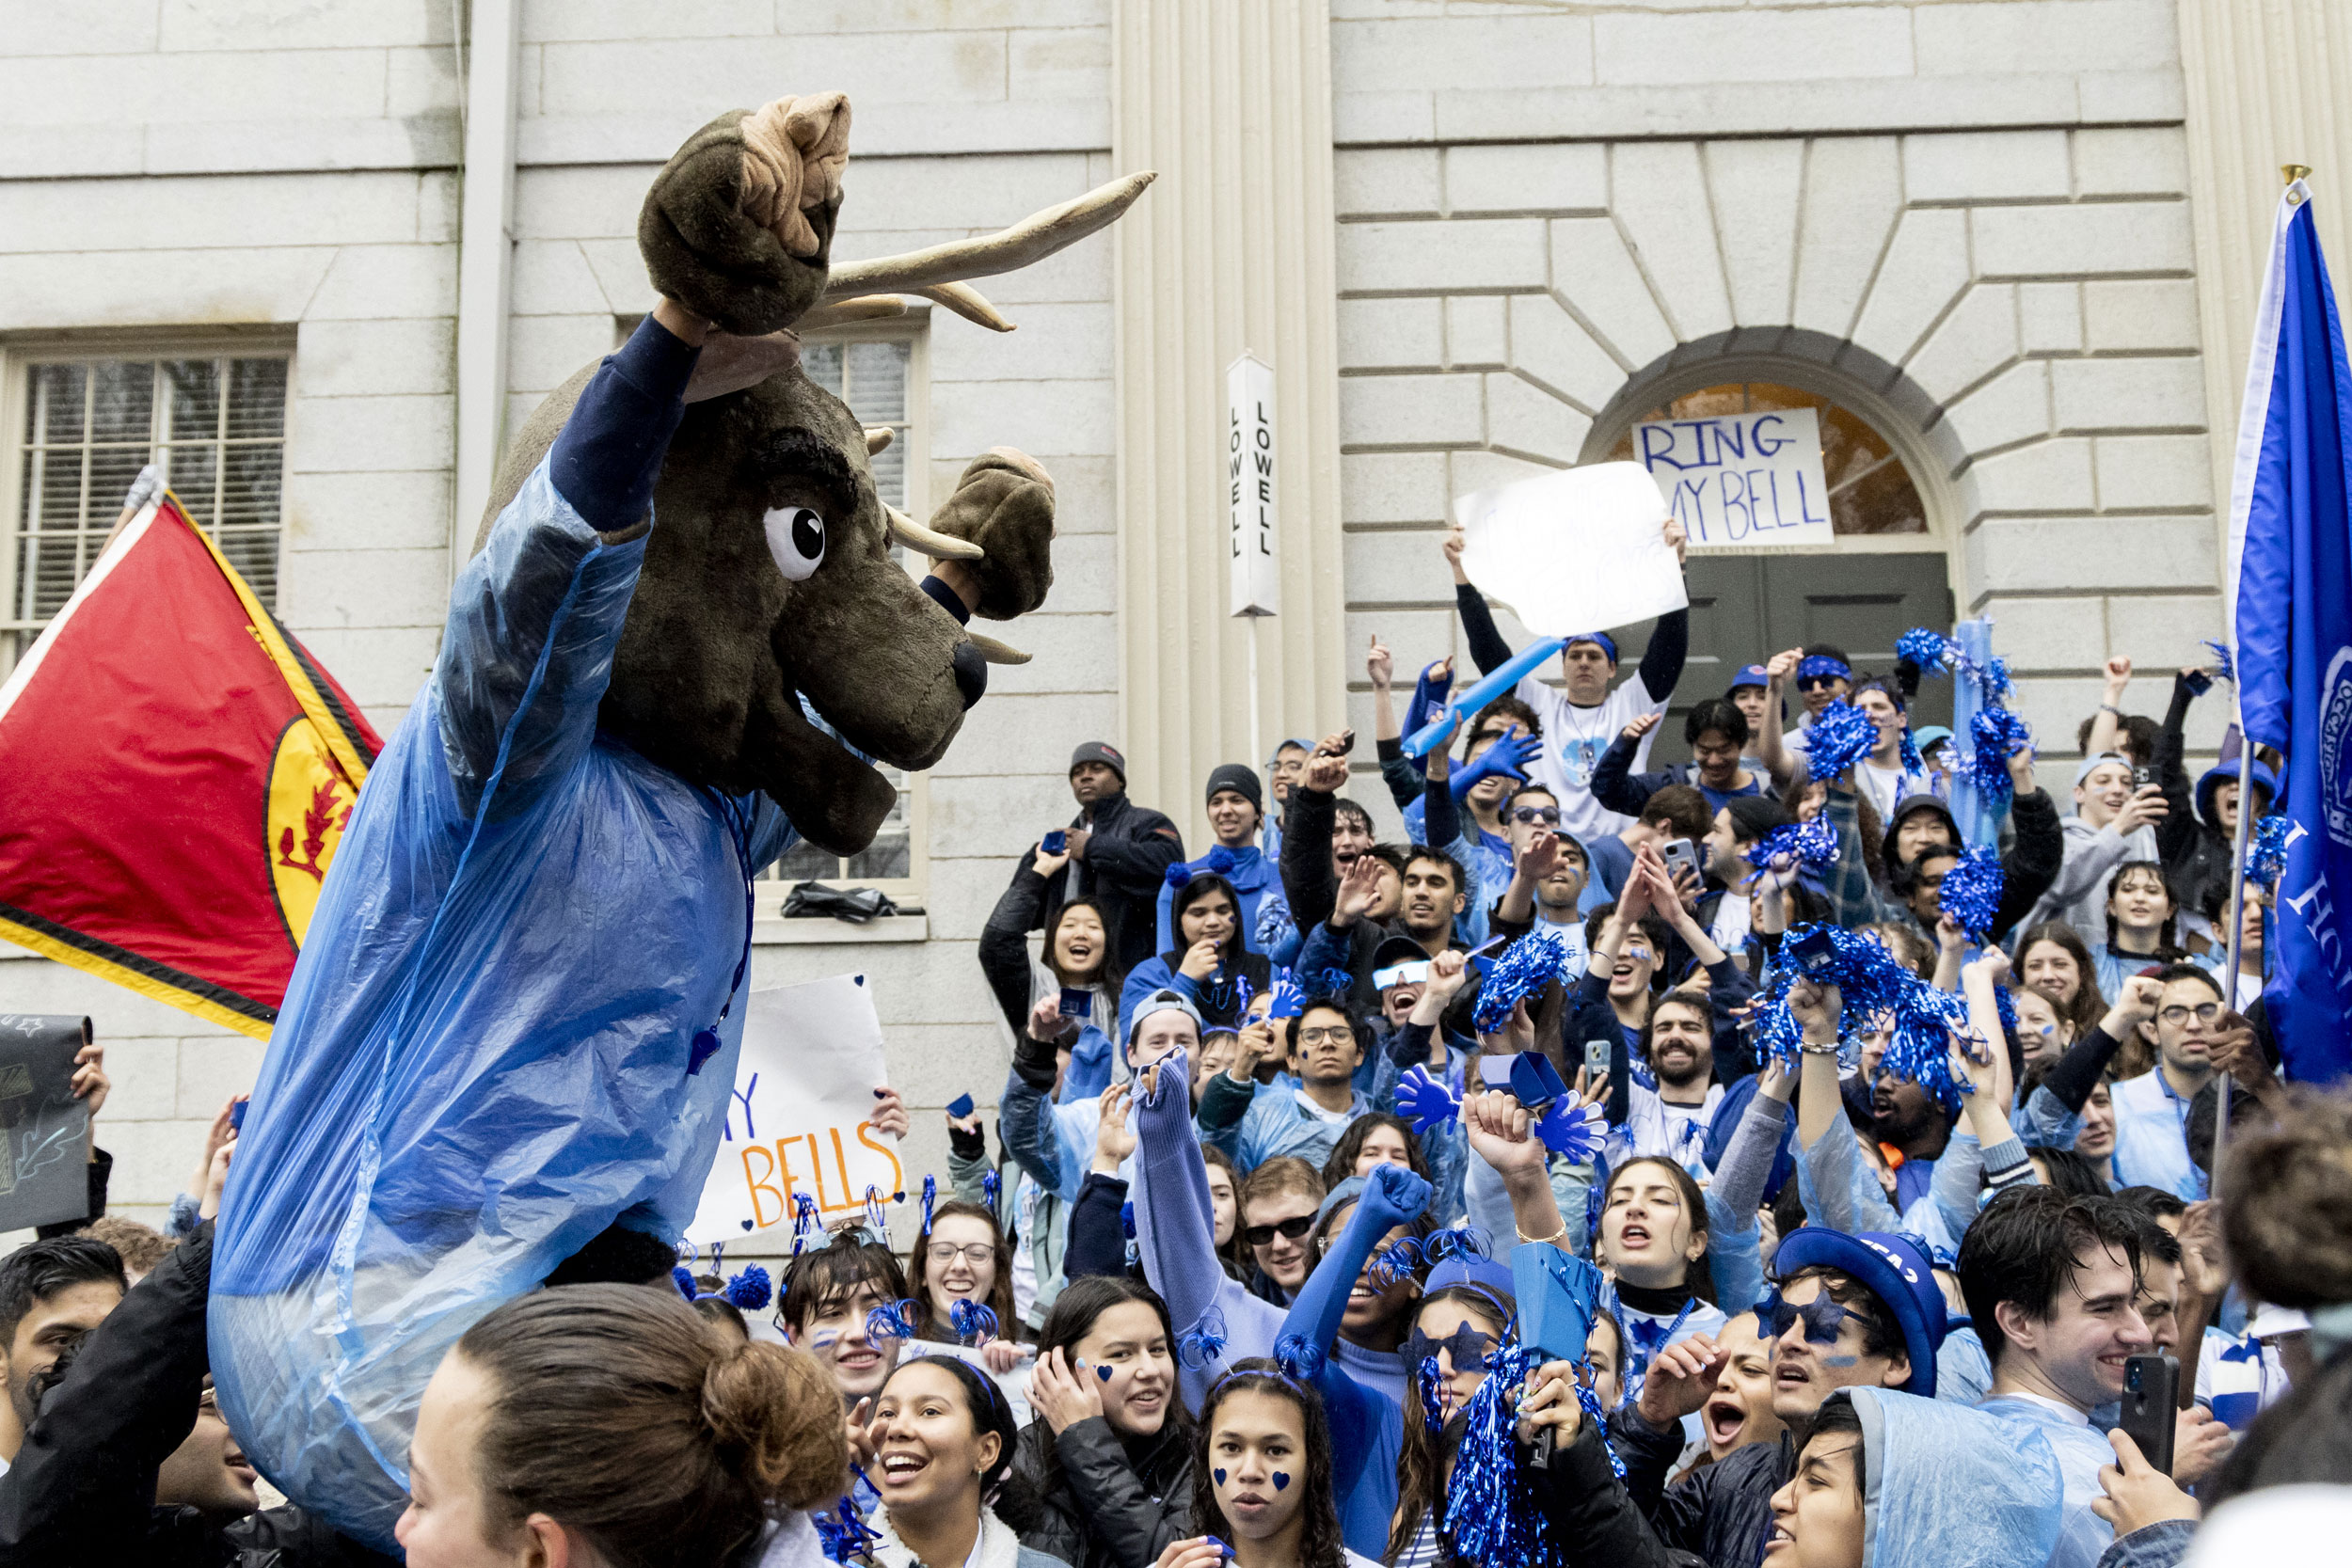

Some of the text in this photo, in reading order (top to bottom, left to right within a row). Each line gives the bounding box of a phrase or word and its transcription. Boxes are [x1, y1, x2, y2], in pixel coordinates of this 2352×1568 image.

[1254, 400, 1272, 557] LOWELL
[1640, 415, 1797, 474] RING
[1230, 406, 1242, 559] LOWELL
[1720, 469, 1826, 541] BELL
[1687, 546, 1756, 555] NIVERSITY
[724, 1072, 758, 1141] Y
[741, 1120, 902, 1228] BELLS
